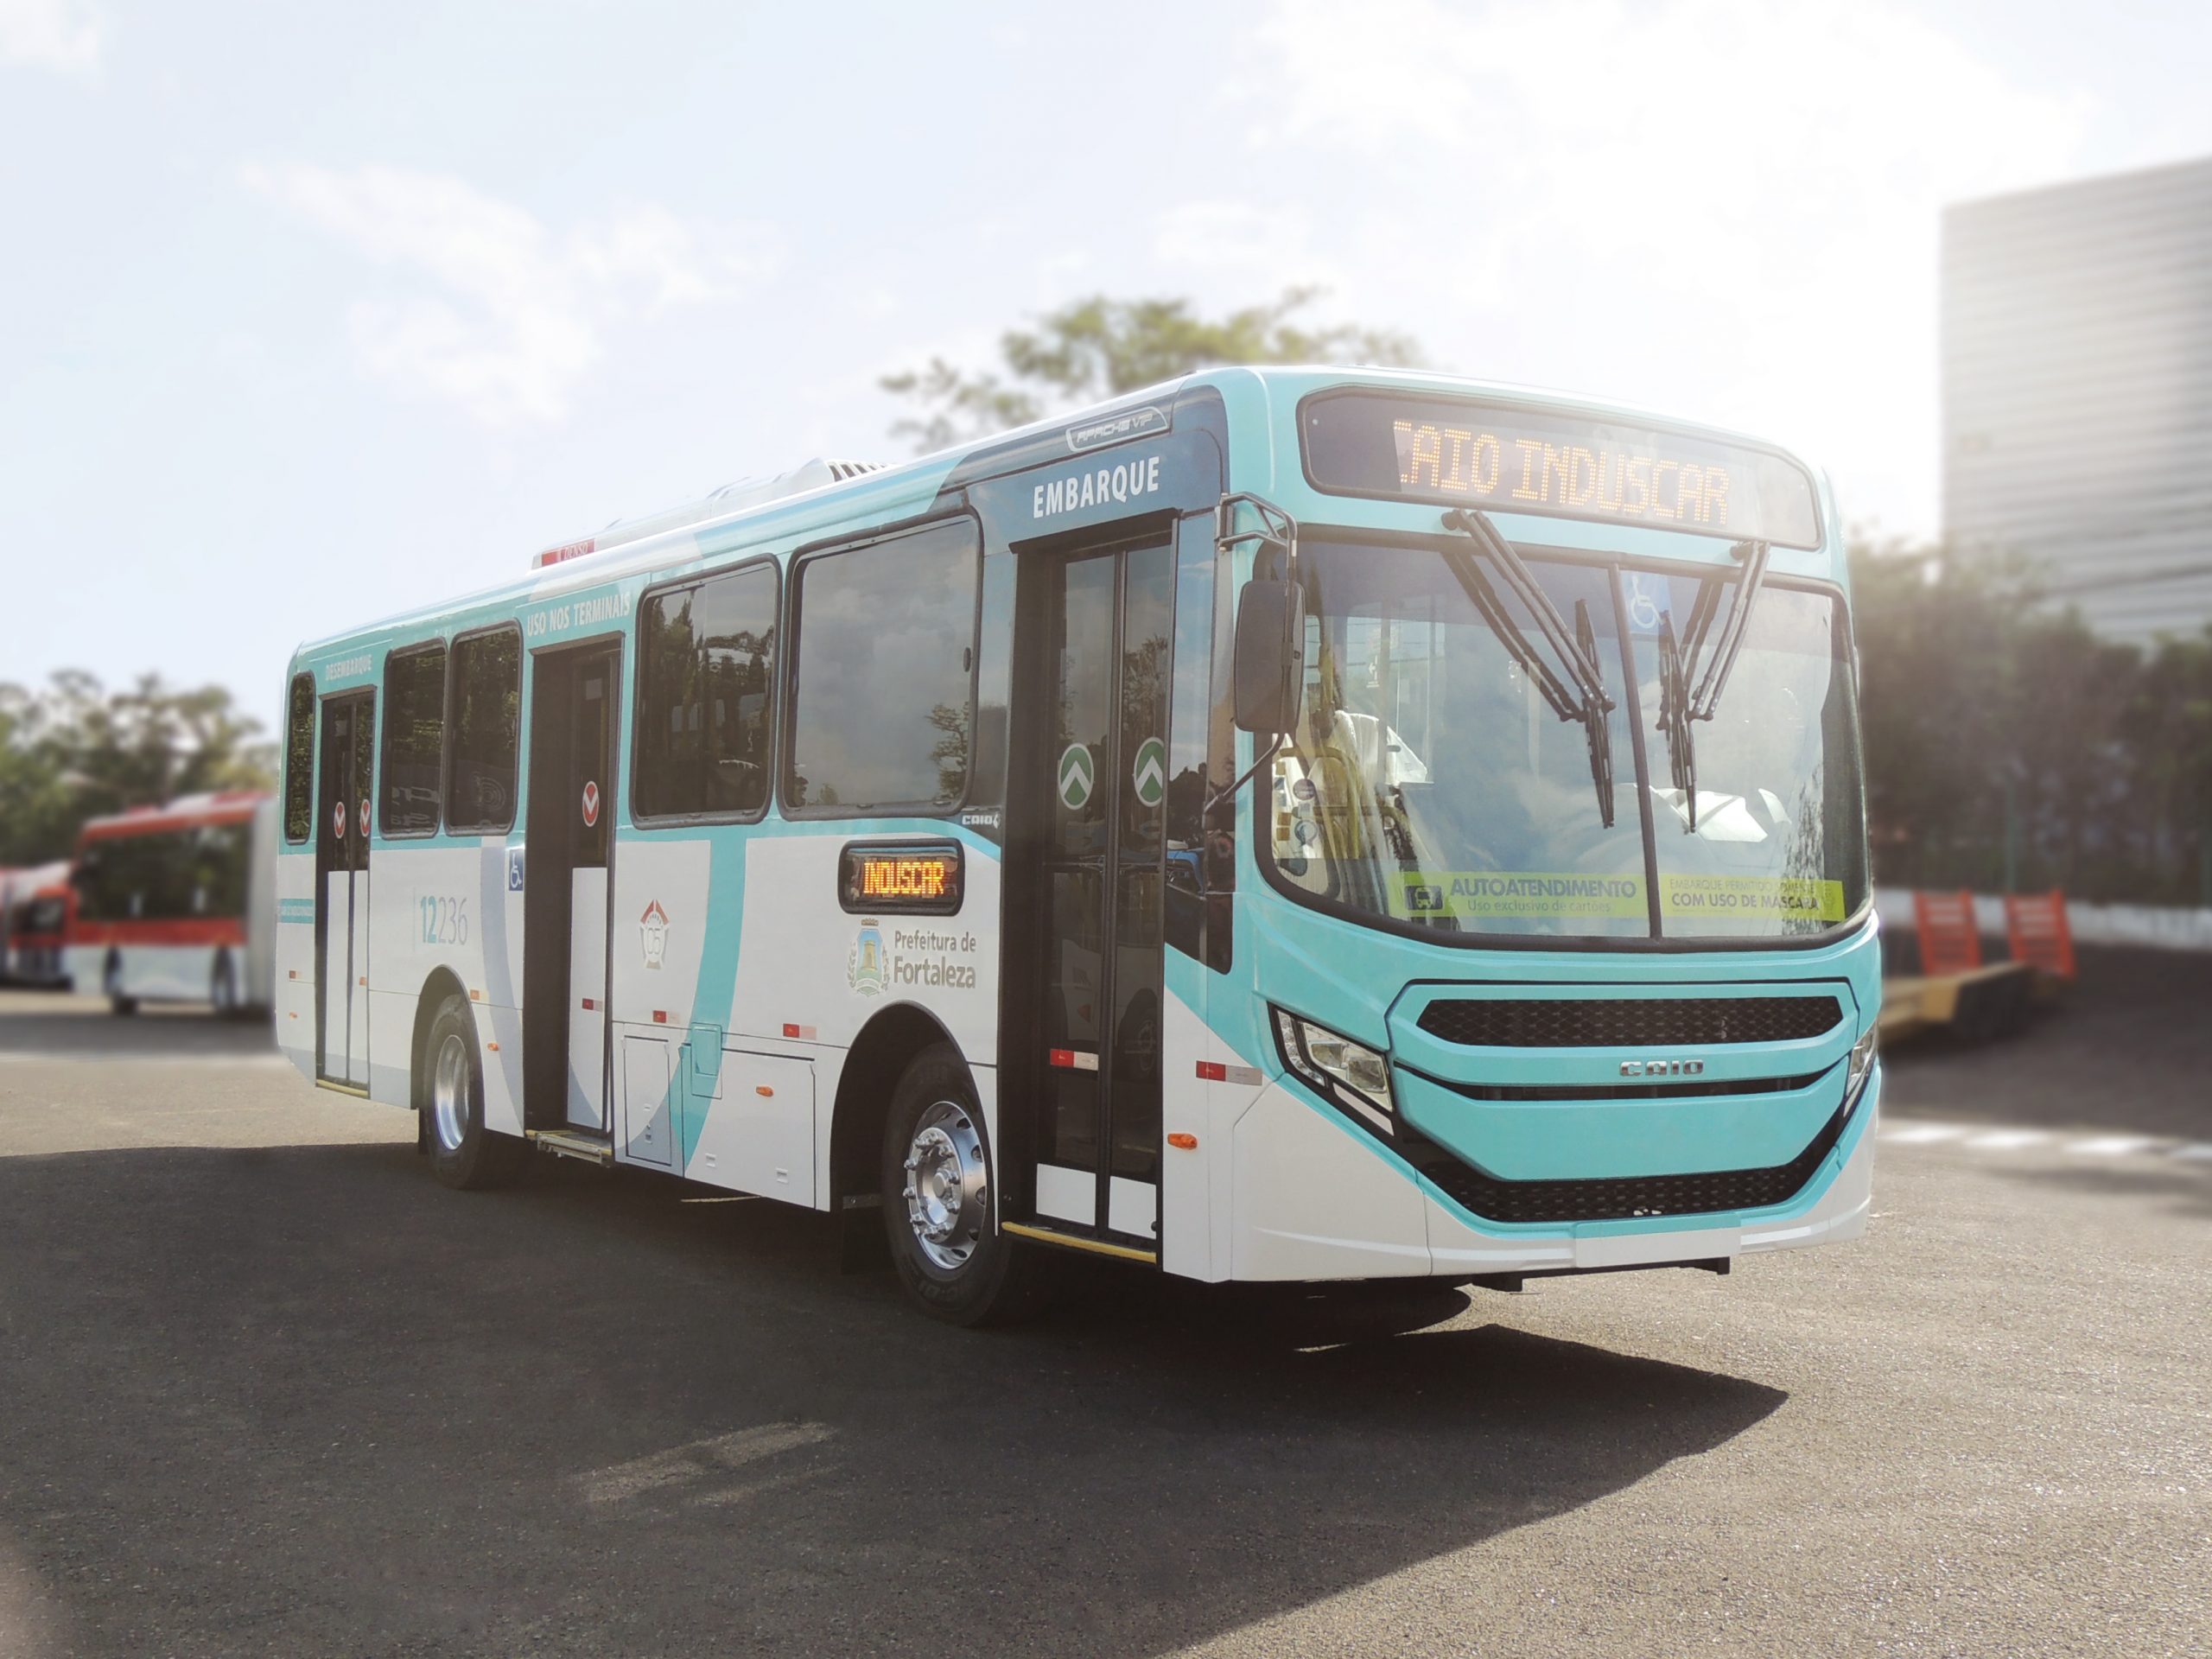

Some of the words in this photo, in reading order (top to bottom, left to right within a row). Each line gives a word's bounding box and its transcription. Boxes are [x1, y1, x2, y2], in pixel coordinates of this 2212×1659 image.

[1130, 413, 1154, 428] VIP
[1033, 456, 1160, 518] EMBARQUE
[1512, 439, 1729, 525] INDUSCAR
[527, 612, 546, 637] USO
[550, 606, 570, 632] NOS
[574, 591, 631, 626] TERMINAIS
[326, 654, 372, 681] DESEMBARQUE
[962, 815, 993, 825] CAIO
[863, 861, 945, 894] INDUSCAR
[1450, 878, 1637, 899] AUTOATENDIMENTO
[1670, 879, 1722, 892] EMBARQUE
[1726, 880, 1772, 893] PERMITIDO
[1467, 899, 1491, 912] Uso
[1494, 899, 1549, 912] exclusivo
[1552, 900, 1567, 912] de
[1672, 893, 1705, 906] COM
[1709, 893, 1737, 907] USO
[1741, 894, 1757, 907] DE
[421, 896, 467, 945] 12236
[894, 930, 957, 950] Prefeitura
[961, 931, 976, 952] de
[893, 956, 976, 988] Fortaleza
[1620, 1059, 1704, 1077] CAIO
